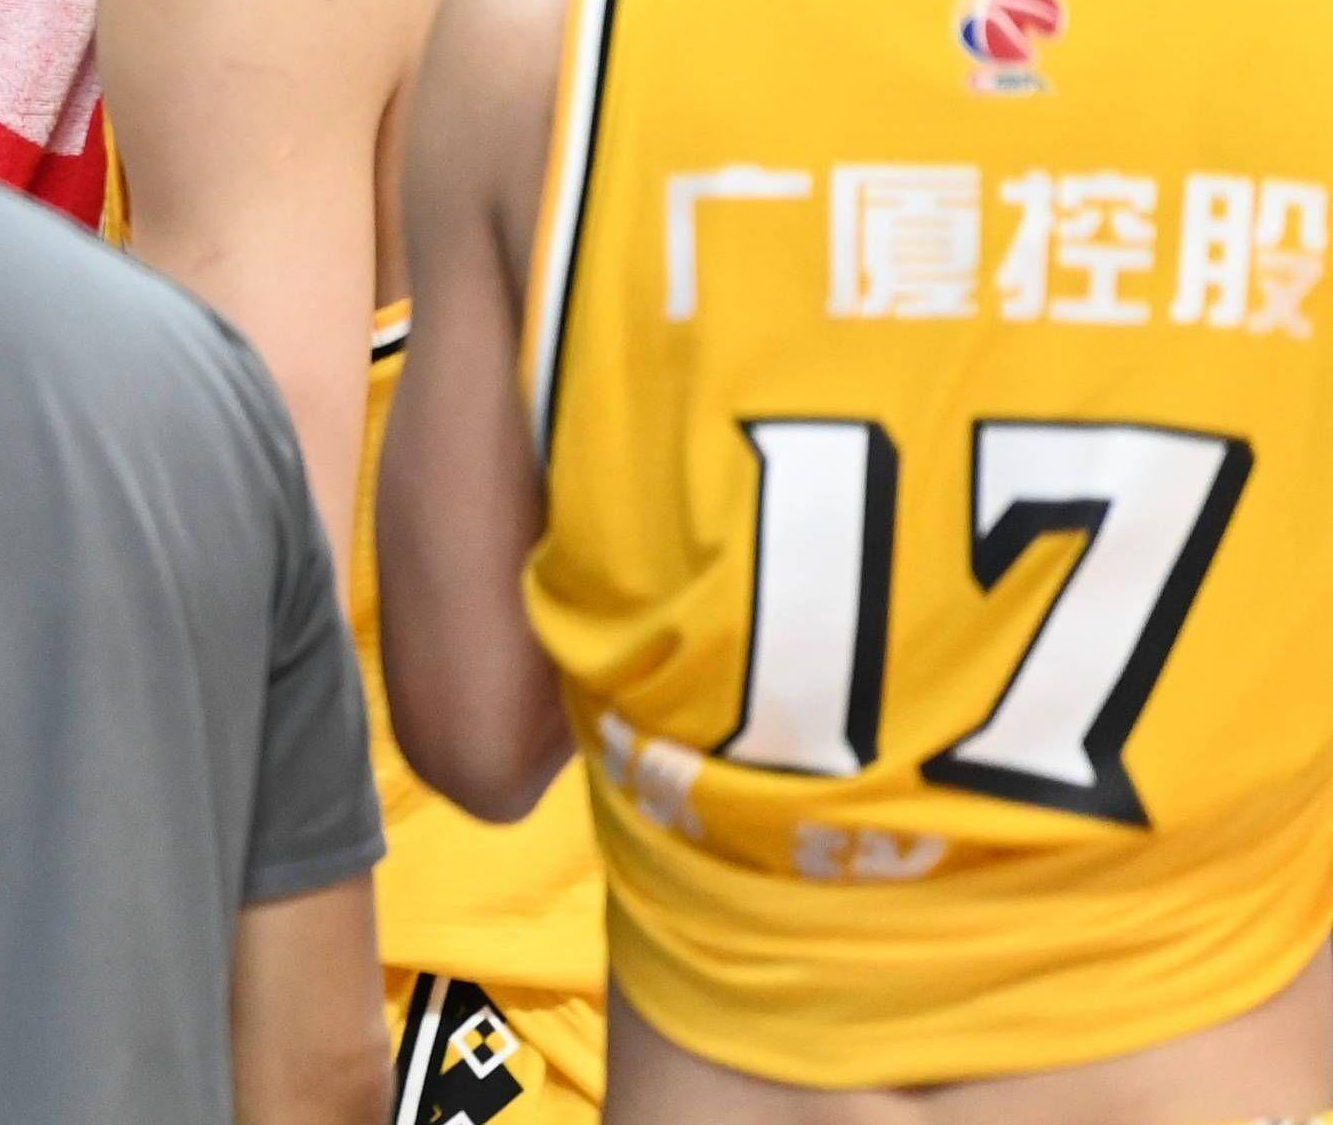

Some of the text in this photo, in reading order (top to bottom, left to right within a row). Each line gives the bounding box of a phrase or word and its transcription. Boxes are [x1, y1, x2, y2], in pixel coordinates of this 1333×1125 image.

[664, 162, 1329, 338] 广厦控股
[713, 417, 1255, 831] 17
